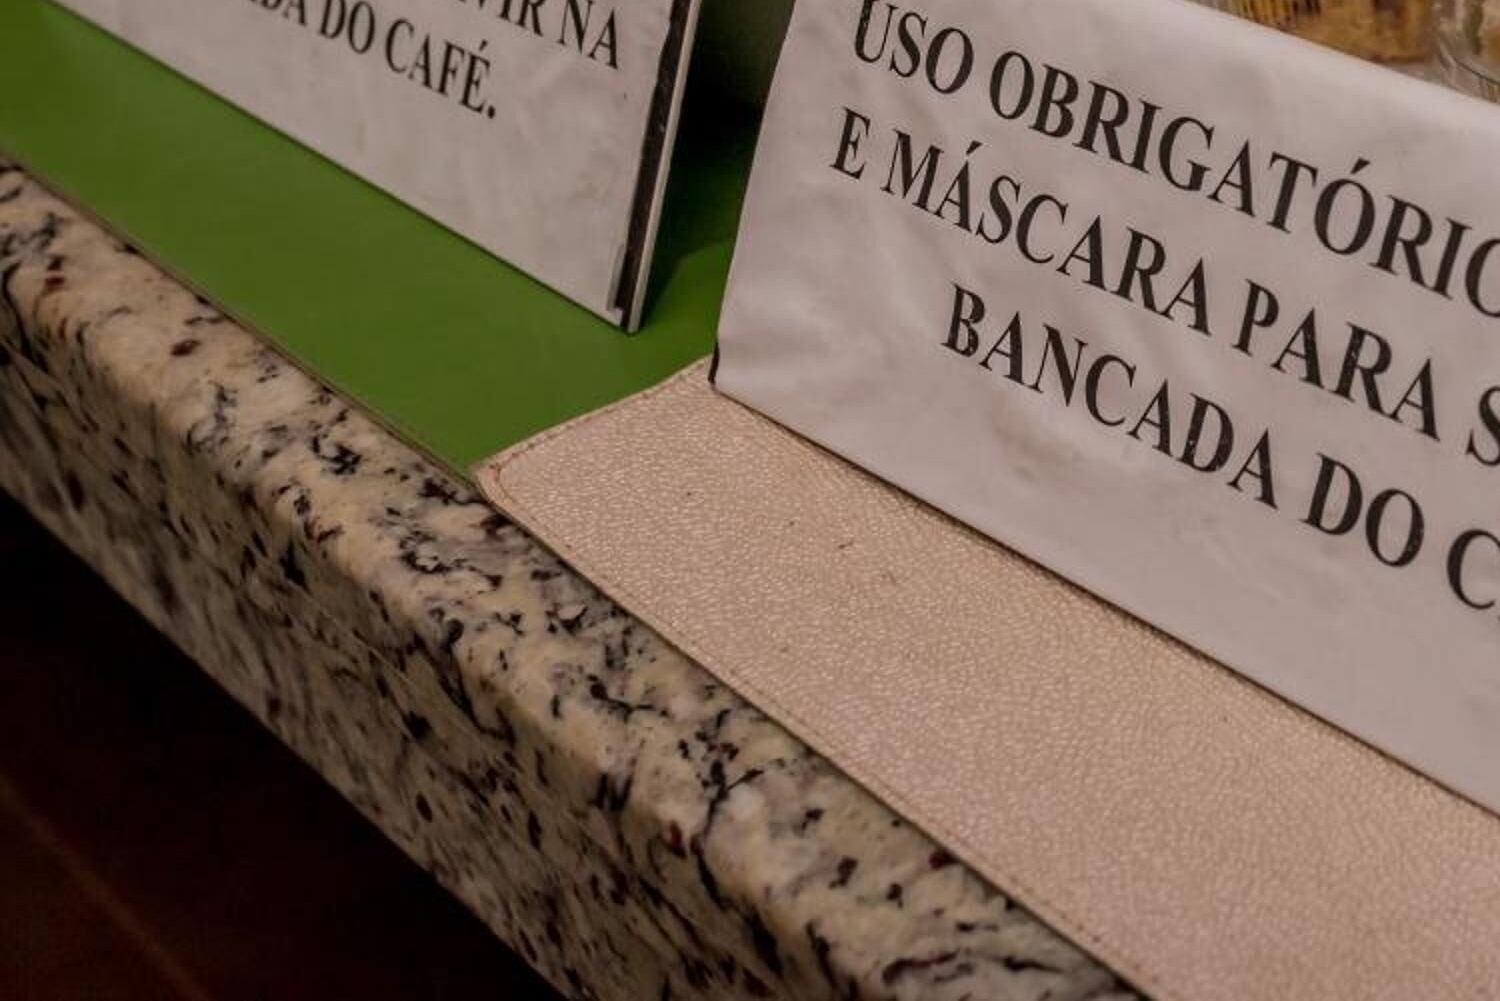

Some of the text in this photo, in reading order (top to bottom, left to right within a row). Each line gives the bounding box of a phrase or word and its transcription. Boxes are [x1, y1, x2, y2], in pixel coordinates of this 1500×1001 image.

[384, 18, 498, 120] CAFÉ.
[829, 106, 871, 180] E
[880, 128, 1212, 337] MÁSCARA
[1231, 278, 1441, 442] PARA
[940, 283, 1278, 509] BANCADA
[1302, 452, 1425, 570] DO
